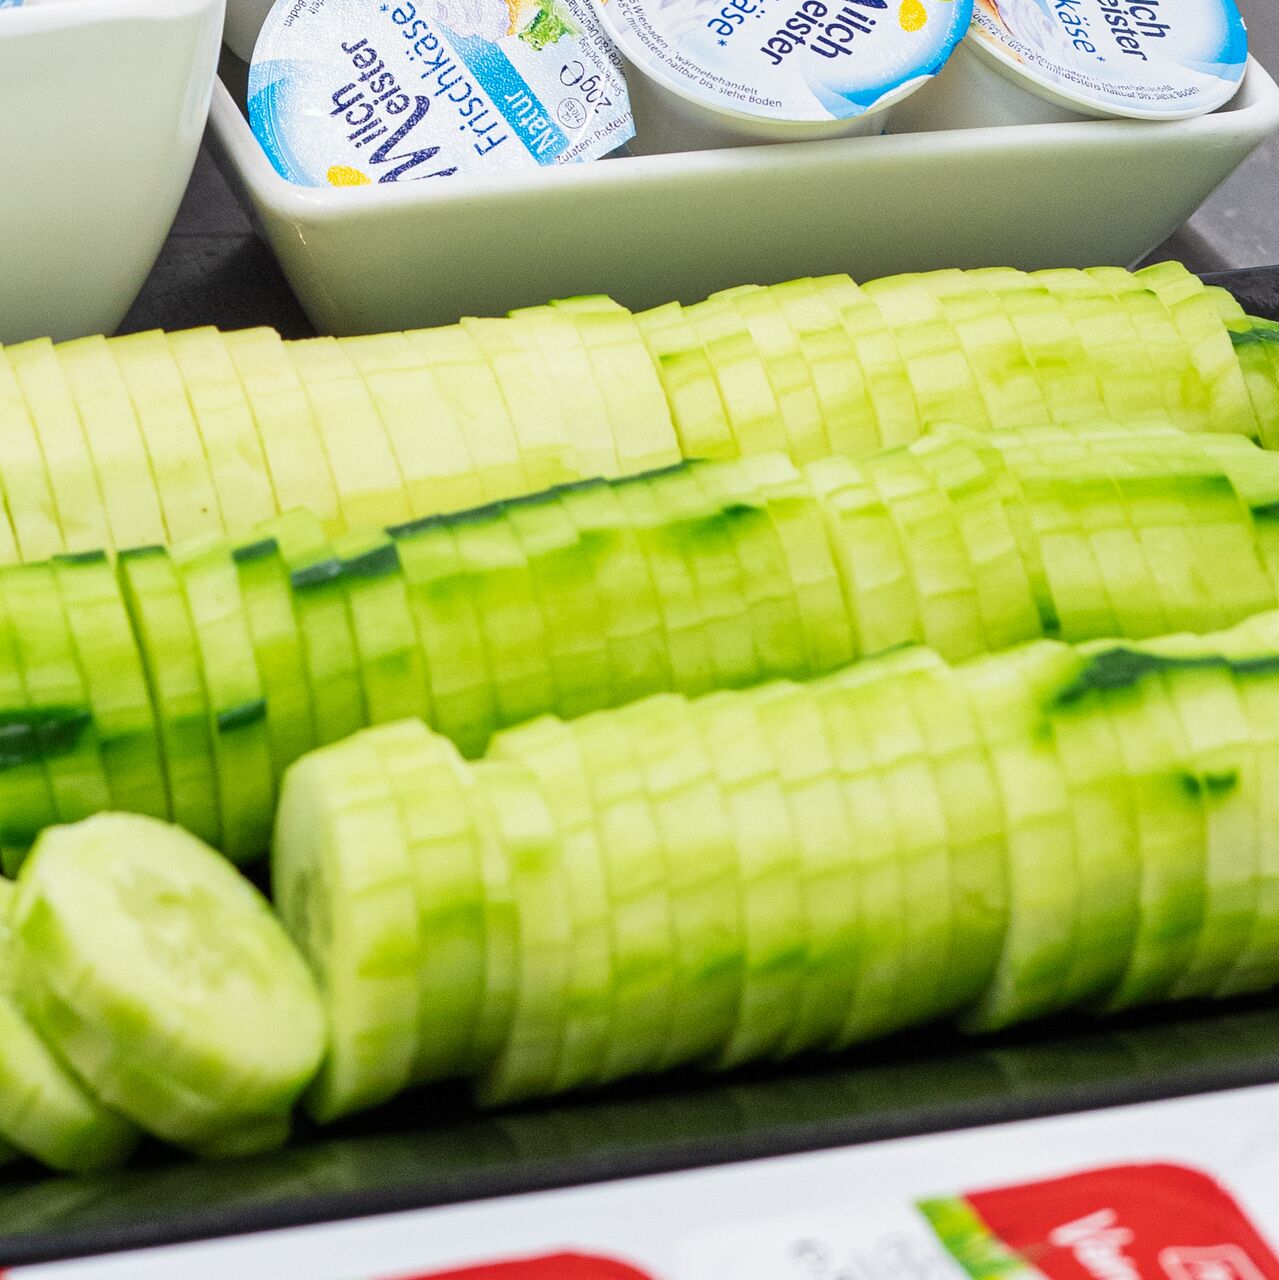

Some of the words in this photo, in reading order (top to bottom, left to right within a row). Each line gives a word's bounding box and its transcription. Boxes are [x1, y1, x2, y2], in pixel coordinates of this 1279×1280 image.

[504, 88, 559, 155] Natur
[579, 74, 612, 114] 20g
[330, 81, 459, 184] Milch
